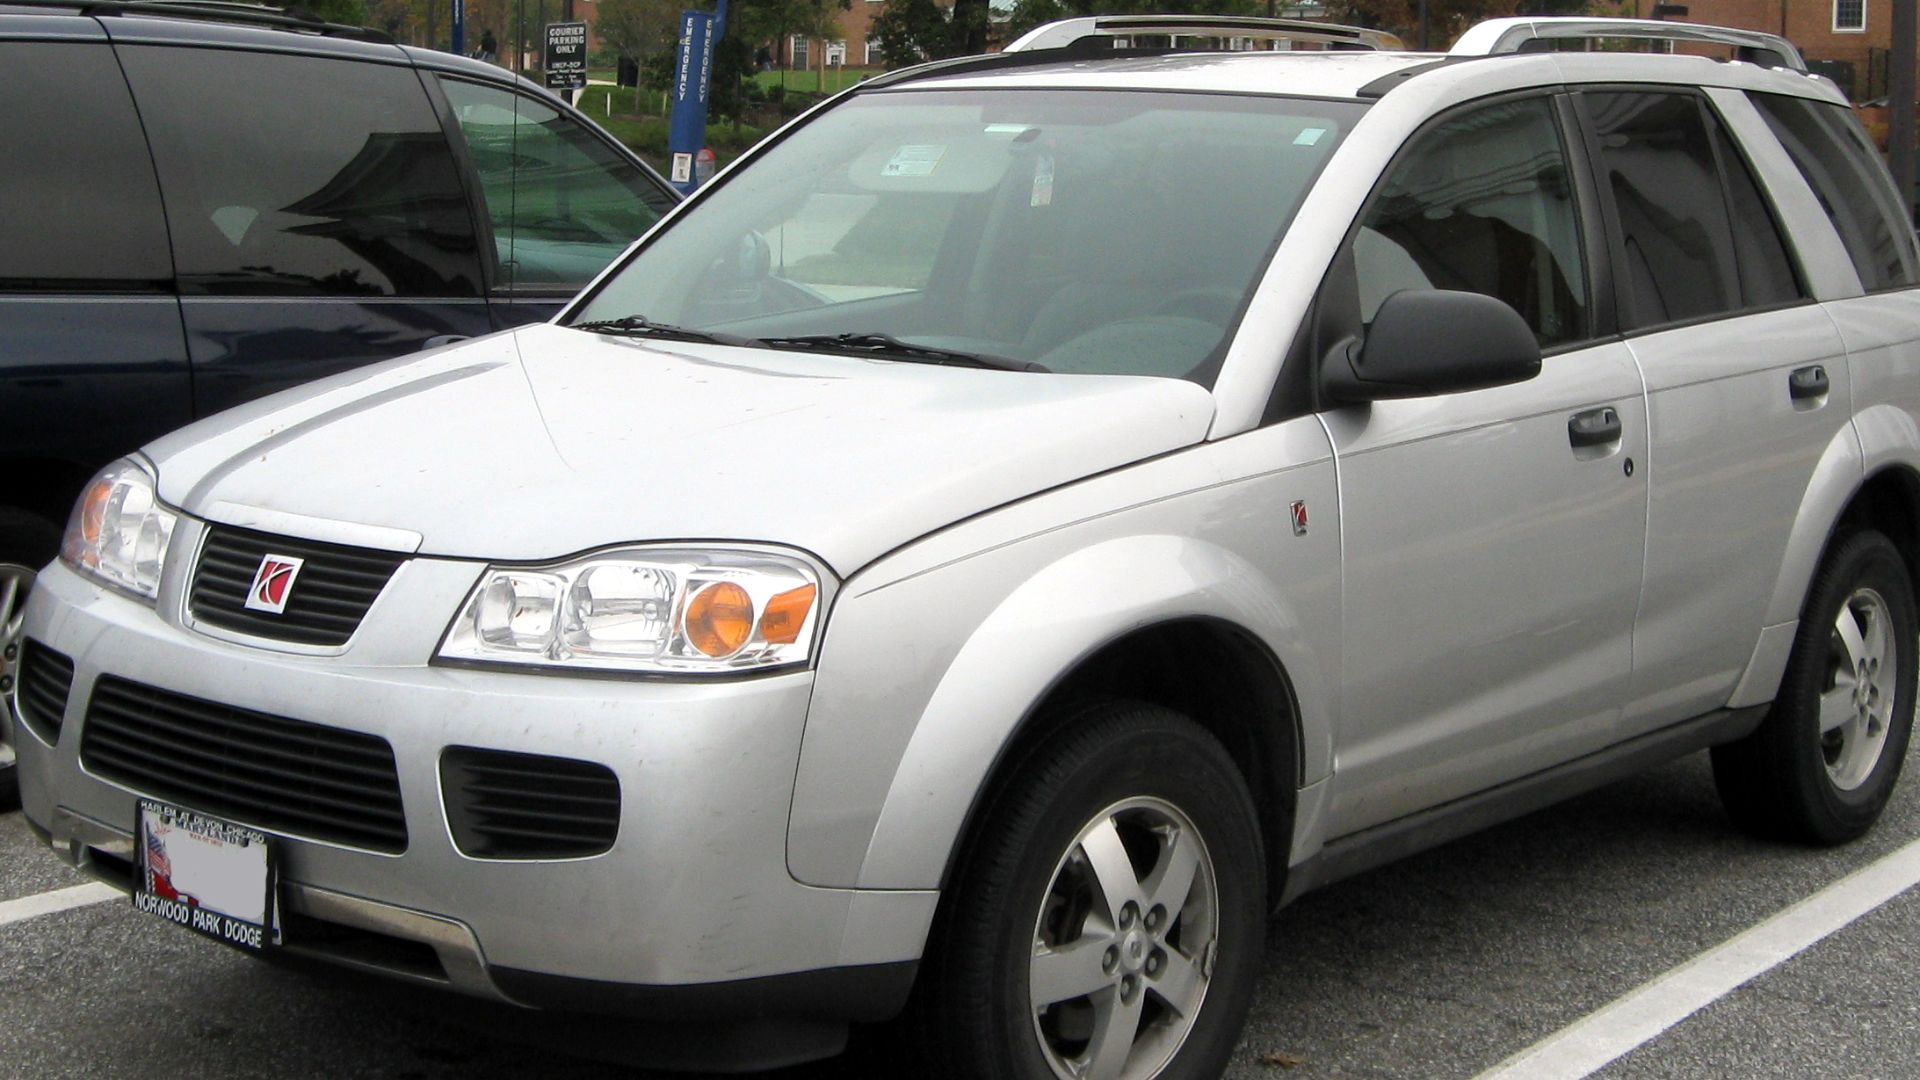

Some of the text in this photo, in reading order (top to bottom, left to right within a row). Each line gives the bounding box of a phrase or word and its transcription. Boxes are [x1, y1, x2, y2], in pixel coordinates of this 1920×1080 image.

[549, 36, 584, 45] PARKING
[550, 27, 584, 36] COURIER
[556, 45, 576, 54] ONLY
[680, 18, 693, 101] EMERGENCY
[699, 19, 712, 103] EMERGENCY
[141, 801, 176, 817] HARLEM
[180, 812, 189, 822] AT
[194, 815, 223, 832] DEVON
[226, 825, 264, 844] CHICAGO
[135, 891, 262, 949] NORWOOD PARK DODGE
